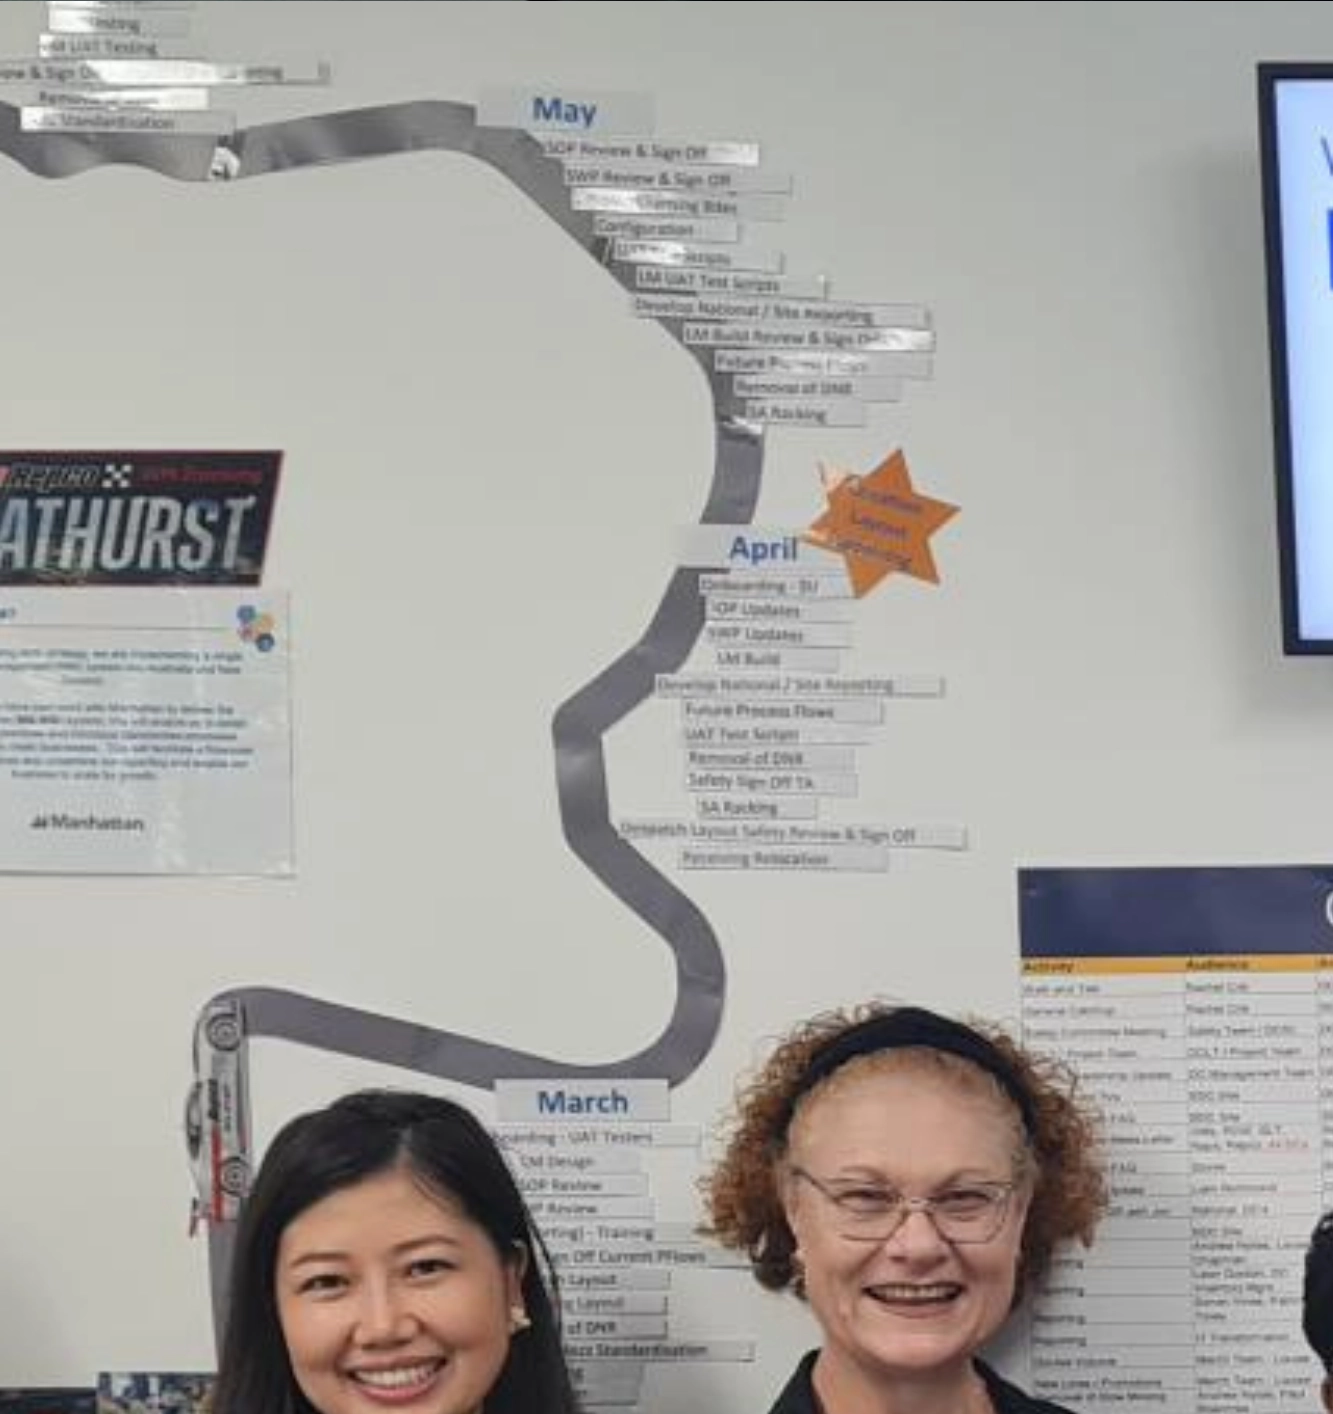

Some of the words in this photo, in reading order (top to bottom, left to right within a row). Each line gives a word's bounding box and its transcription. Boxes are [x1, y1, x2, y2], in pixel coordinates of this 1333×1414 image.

[533, 97, 597, 127] May
[0, 496, 256, 572] ATHURST
[730, 537, 798, 563] April
[52, 813, 144, 831] Manhattan
[1024, 961, 1074, 974] Activity
[1187, 958, 1248, 971] Audience
[538, 1088, 629, 1114] March
